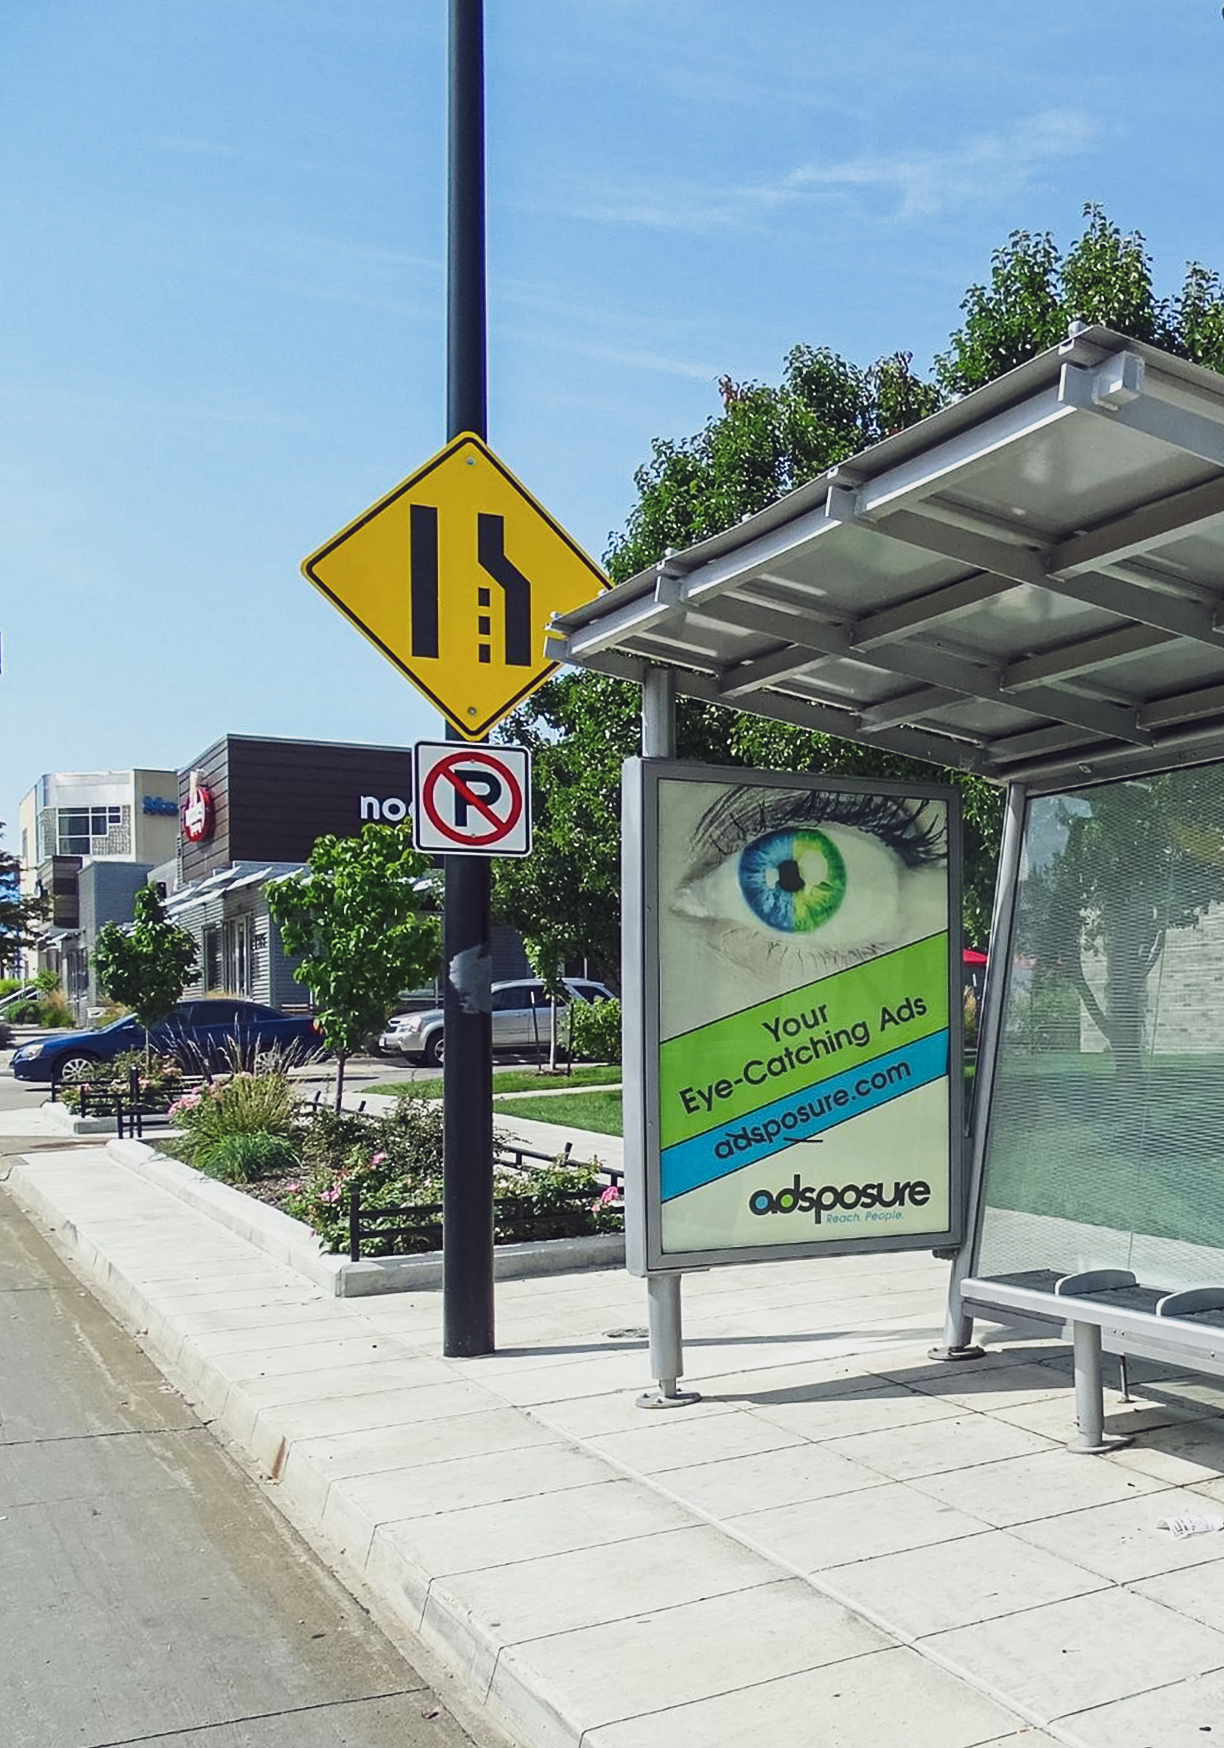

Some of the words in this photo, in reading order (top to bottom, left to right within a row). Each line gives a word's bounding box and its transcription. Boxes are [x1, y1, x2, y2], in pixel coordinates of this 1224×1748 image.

[678, 1020, 871, 1115] Eye-Catching
[879, 997, 928, 1032] Ads
[762, 1004, 829, 1043] Your
[713, 1061, 912, 1160] adsposure.com
[749, 1173, 932, 1225] adsposure
